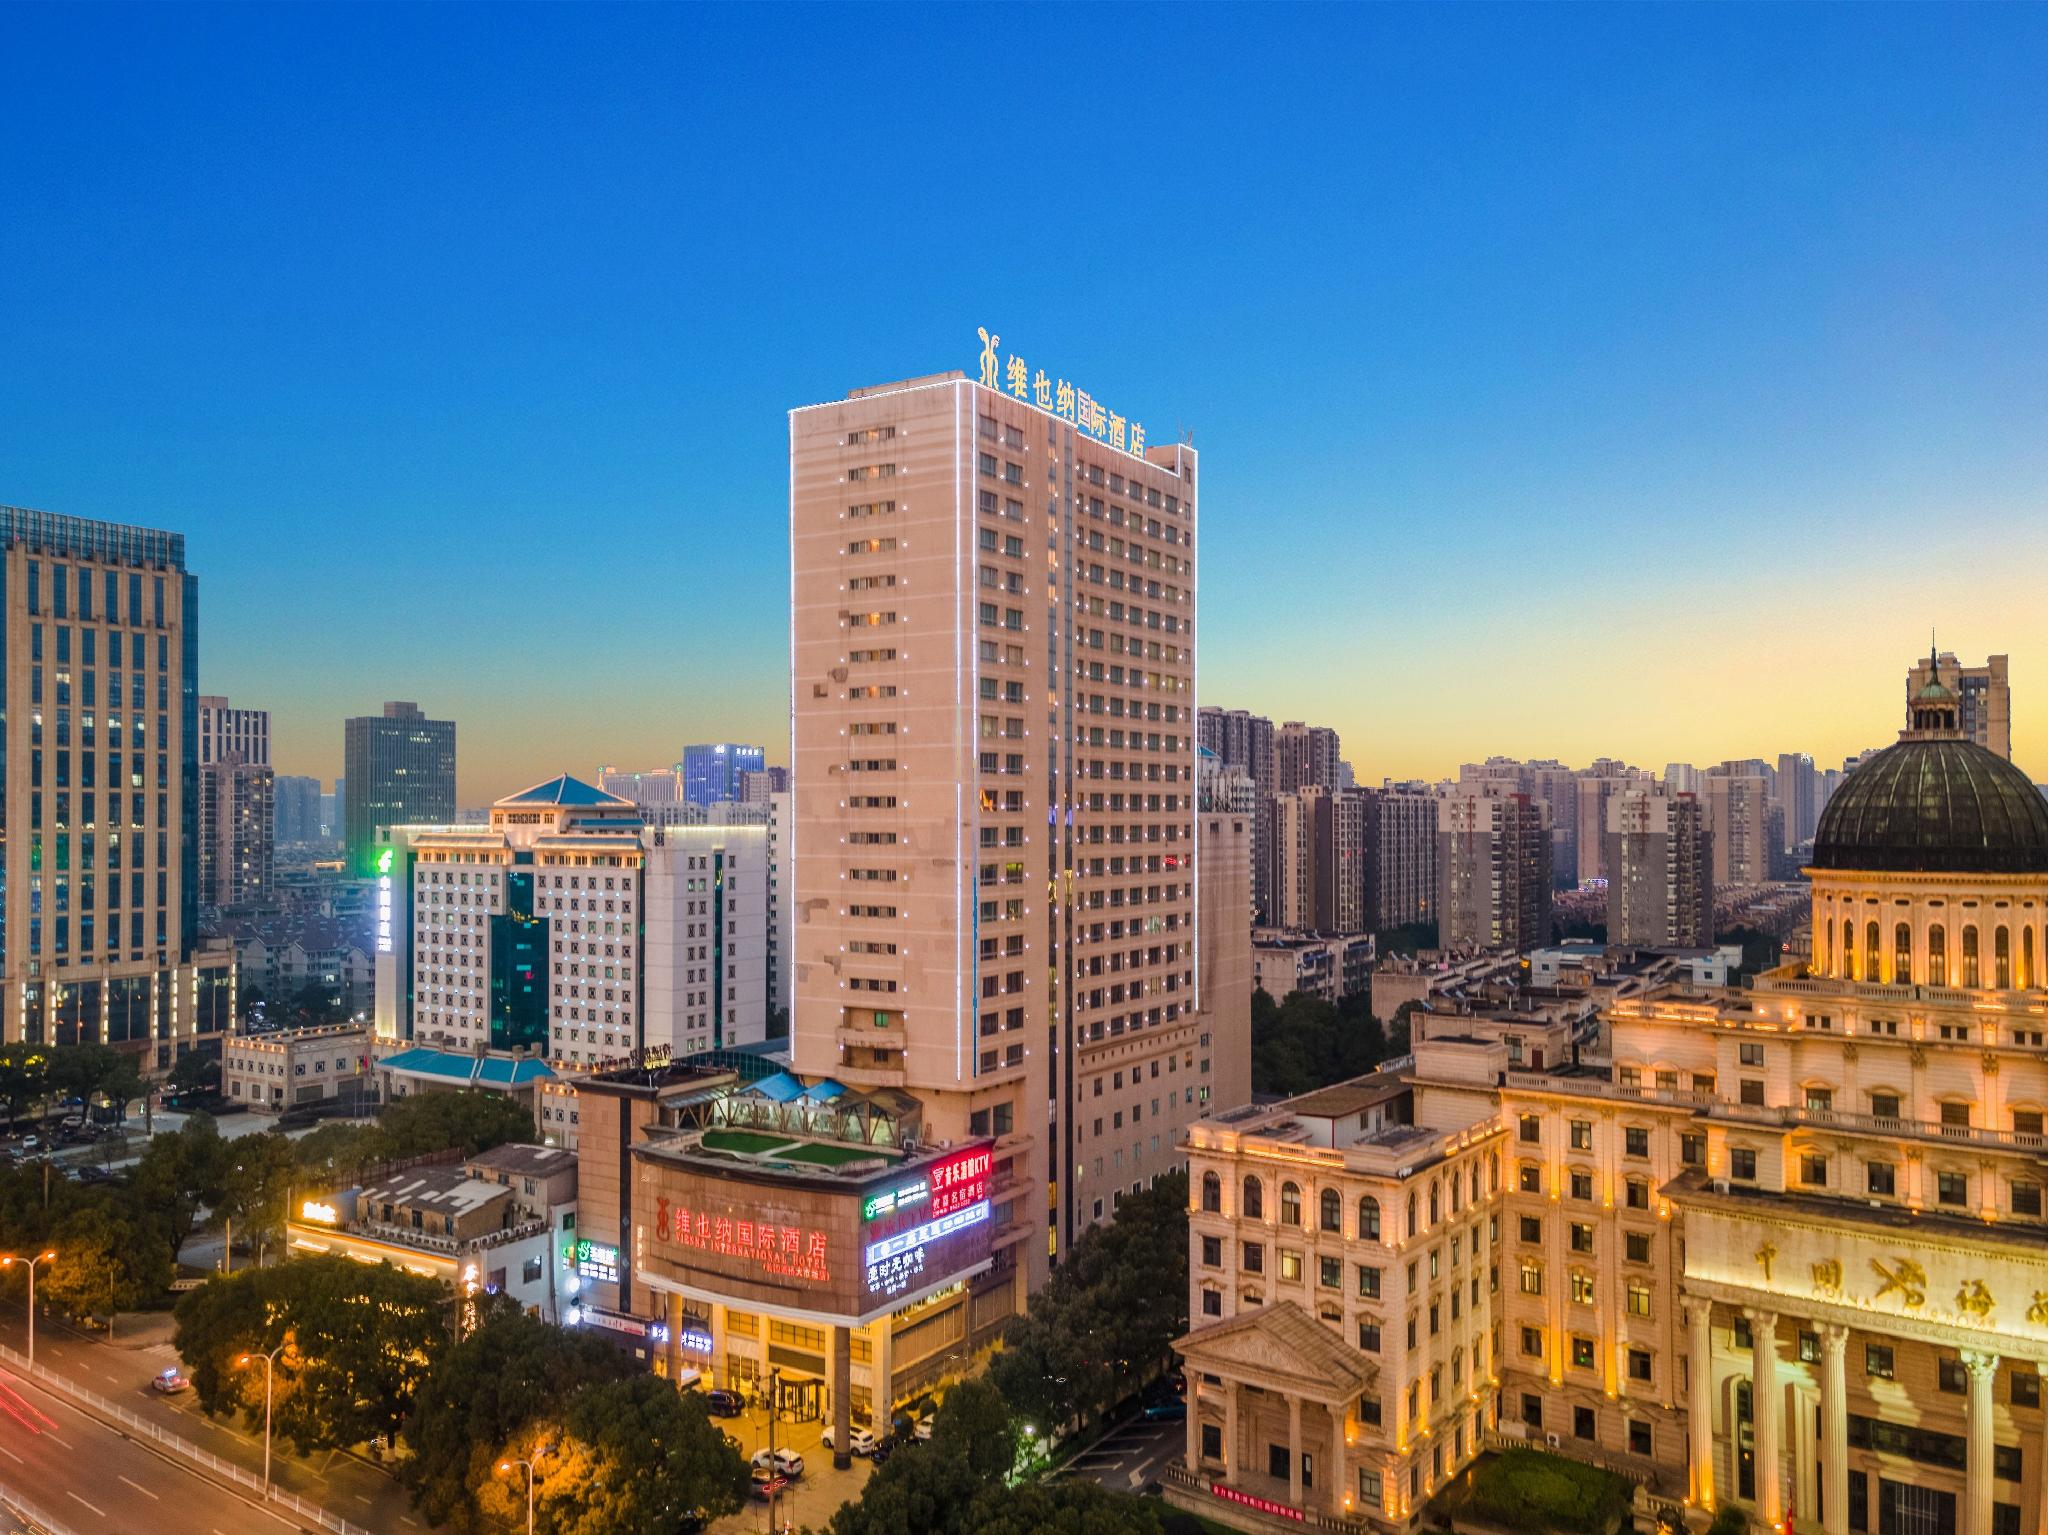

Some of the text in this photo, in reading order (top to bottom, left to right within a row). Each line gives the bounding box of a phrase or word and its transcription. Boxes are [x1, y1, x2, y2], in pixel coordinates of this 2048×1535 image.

[1007, 354, 1146, 458] 维也纳国际酒店
[674, 1207, 828, 1259] 维也纳国际酒店
[676, 1232, 827, 1270] VIENNA INTERNATIONAL HOTEL
